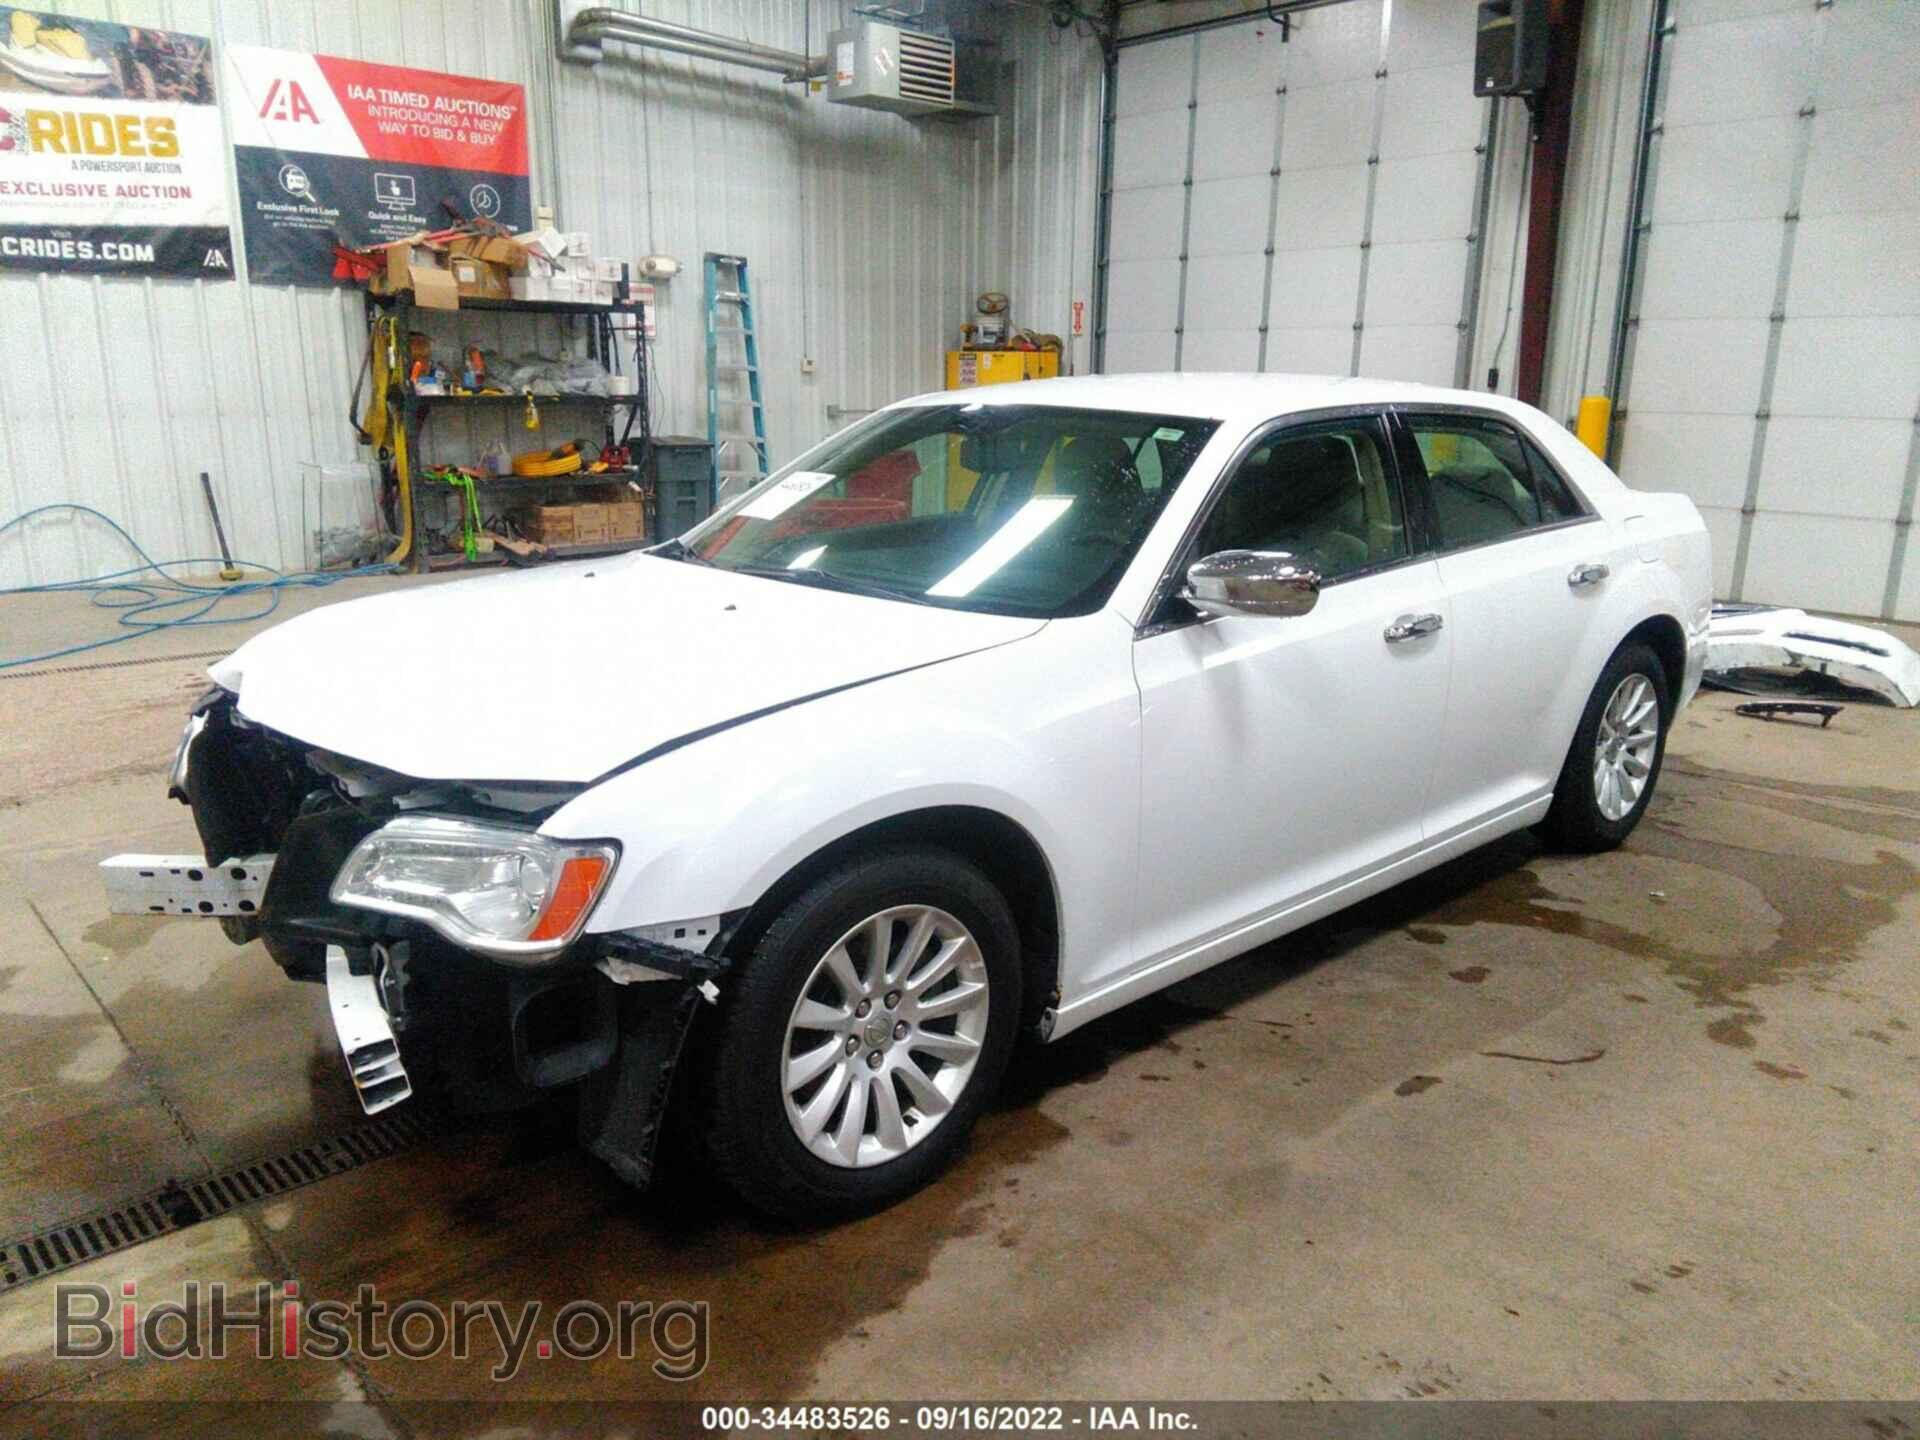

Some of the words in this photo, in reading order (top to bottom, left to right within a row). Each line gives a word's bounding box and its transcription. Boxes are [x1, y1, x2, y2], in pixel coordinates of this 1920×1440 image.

[347, 84, 376, 101] IAA
[379, 89, 429, 108] TIMED
[368, 106, 458, 127] INTRODUCING
[462, 118, 471, 129] A
[473, 117, 504, 132] NEW
[25, 108, 180, 157] RIDES
[378, 121, 407, 135] WAY
[411, 123, 430, 137] TO
[432, 127, 454, 141] BID
[457, 131, 467, 143] &
[470, 133, 496, 145] BUY
[72, 160, 79, 171] A
[80, 160, 141, 173] POWERSPORT
[144, 162, 182, 174] AUCTION
[0, 181, 108, 198] EXCLUSIVE
[116, 184, 192, 199] AUCTION
[256, 201, 298, 213] Exclusive
[368, 211, 391, 221] Quick
[0, 236, 155, 262] CRIDES.COM
